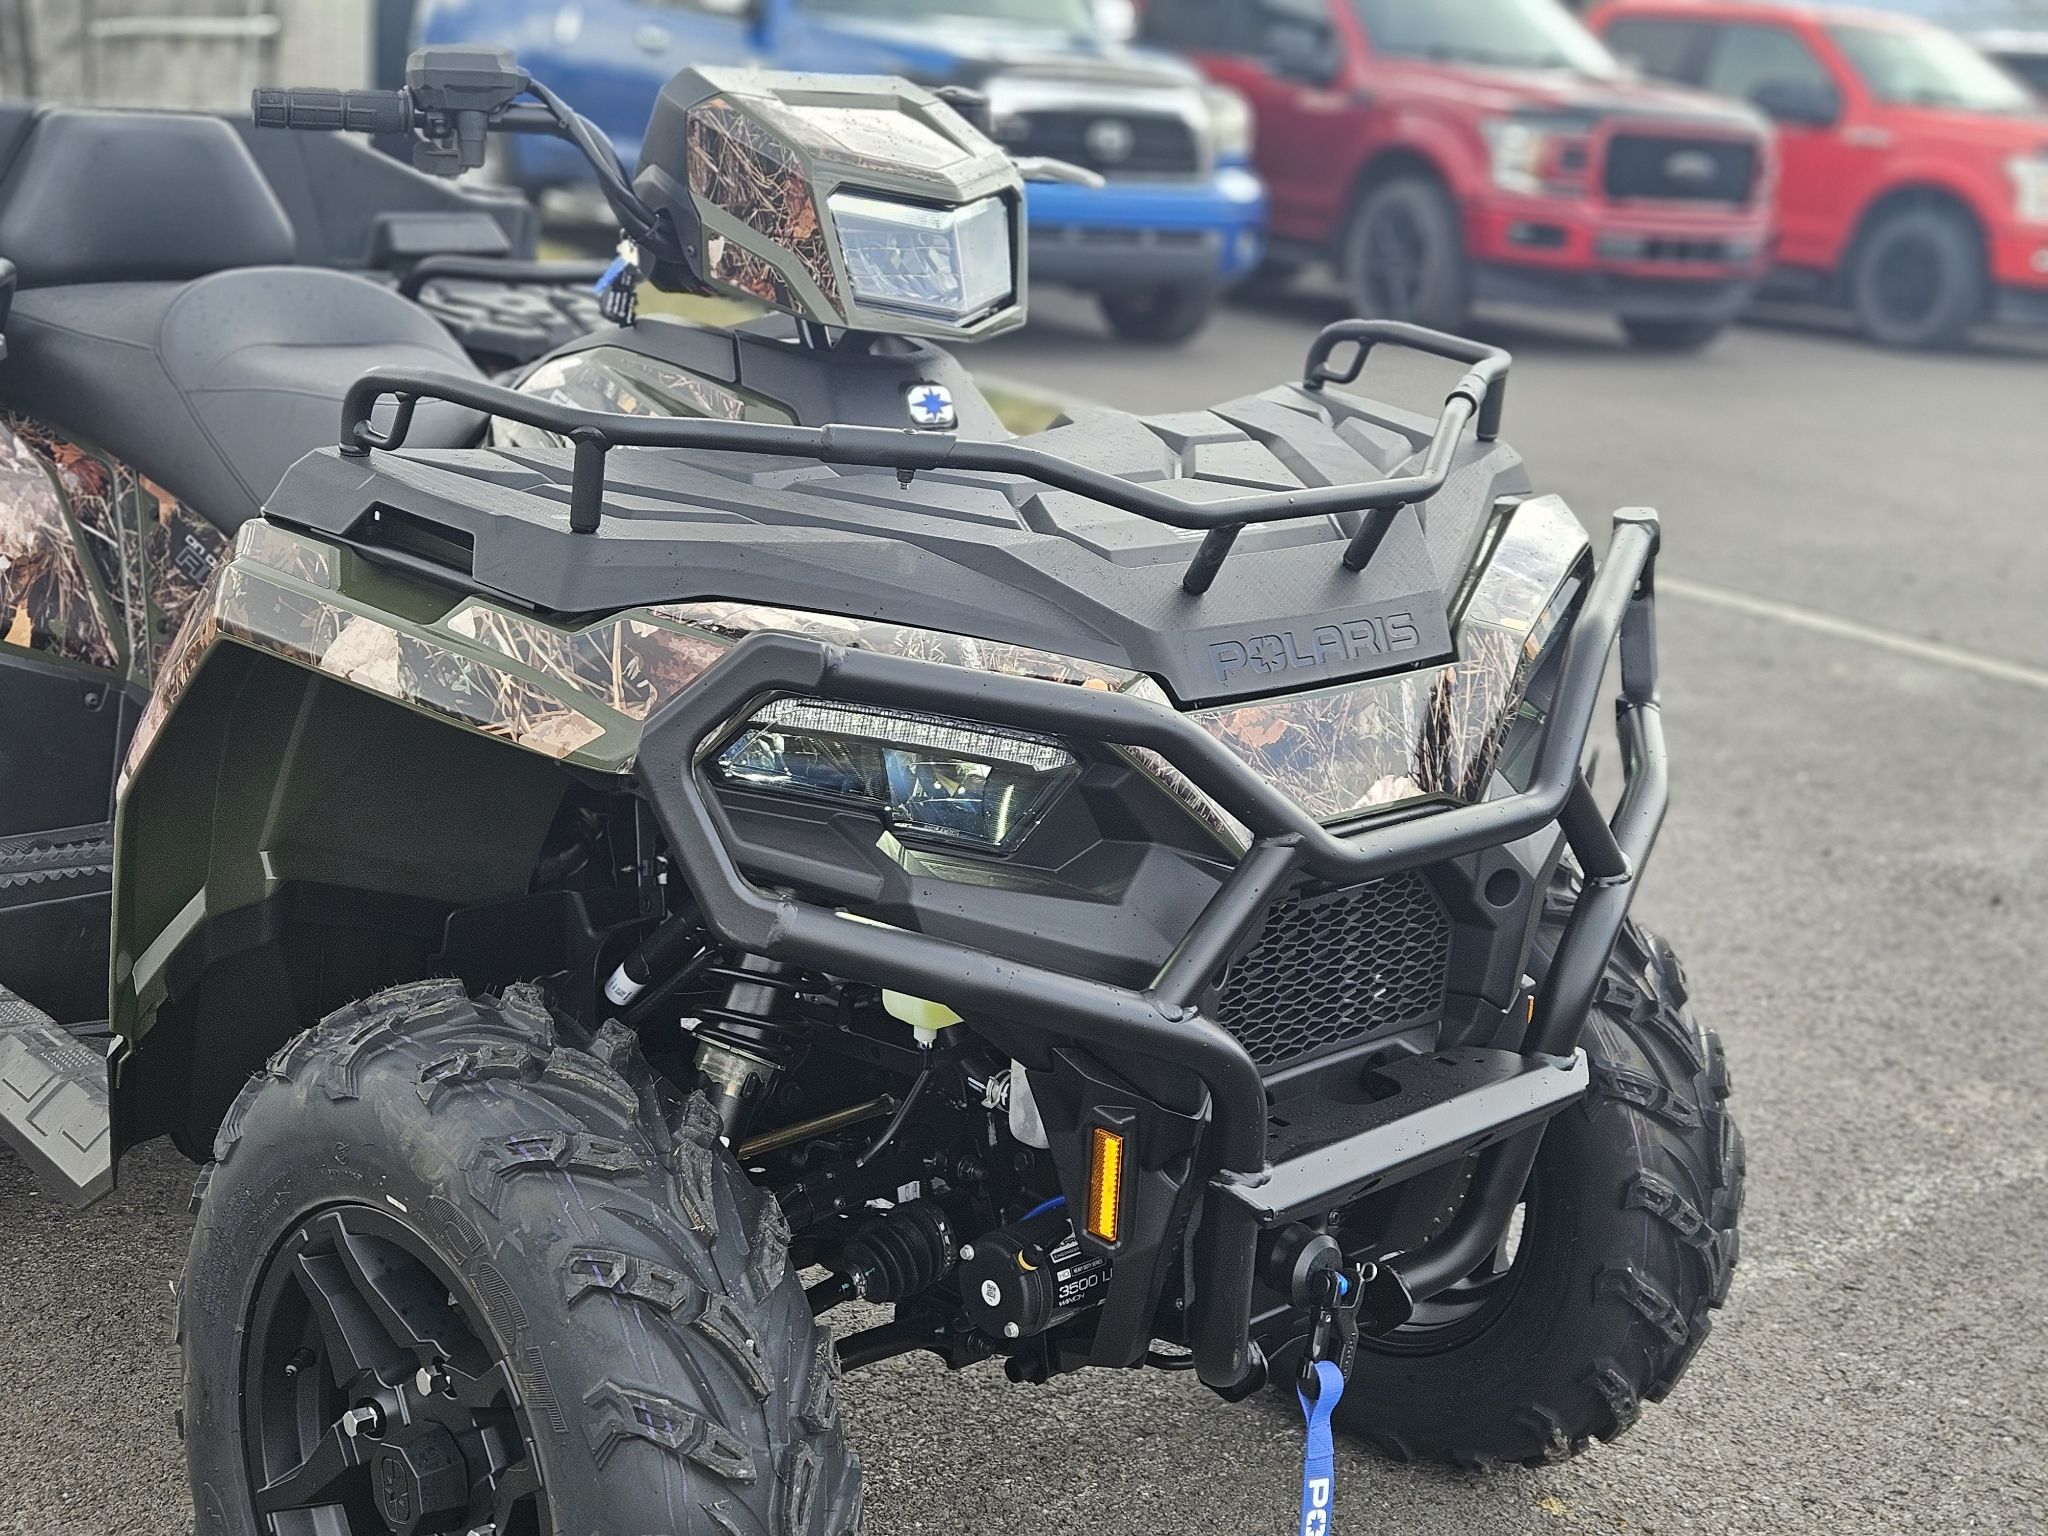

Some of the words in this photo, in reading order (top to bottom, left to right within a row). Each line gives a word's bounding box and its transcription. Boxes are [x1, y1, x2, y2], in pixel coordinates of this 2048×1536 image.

[1208, 612, 1420, 682] POLARIS
[1058, 1292, 1085, 1307] WINCH
[1059, 1274, 1098, 1299] 3500
[424, 1194, 569, 1434] CST
